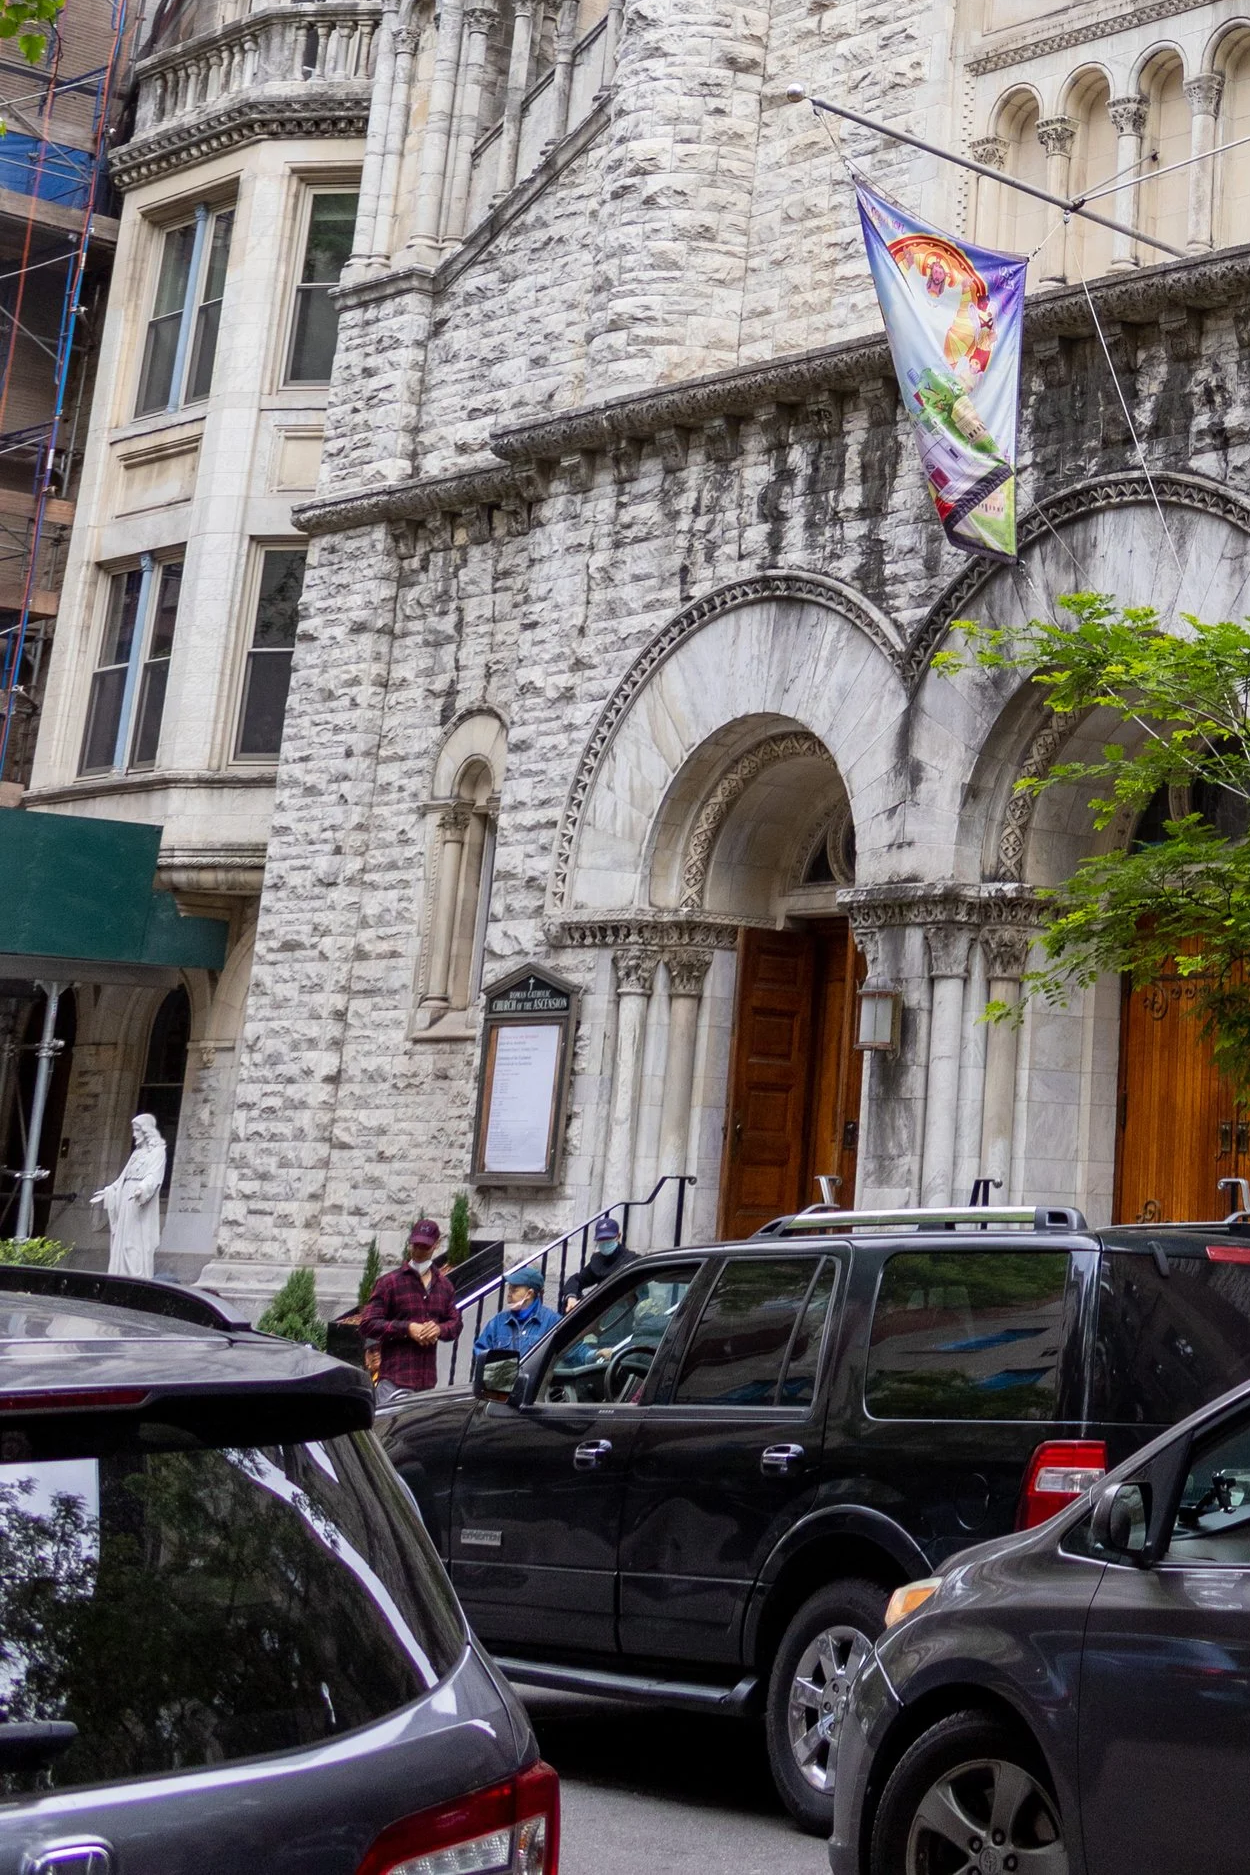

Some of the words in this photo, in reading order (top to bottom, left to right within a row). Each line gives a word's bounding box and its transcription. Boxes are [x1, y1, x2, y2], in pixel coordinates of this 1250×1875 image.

[528, 990, 551, 998] CATHOLIC
[493, 1000, 517, 1011] CHURCH
[533, 997, 567, 1010] ASCENSION
